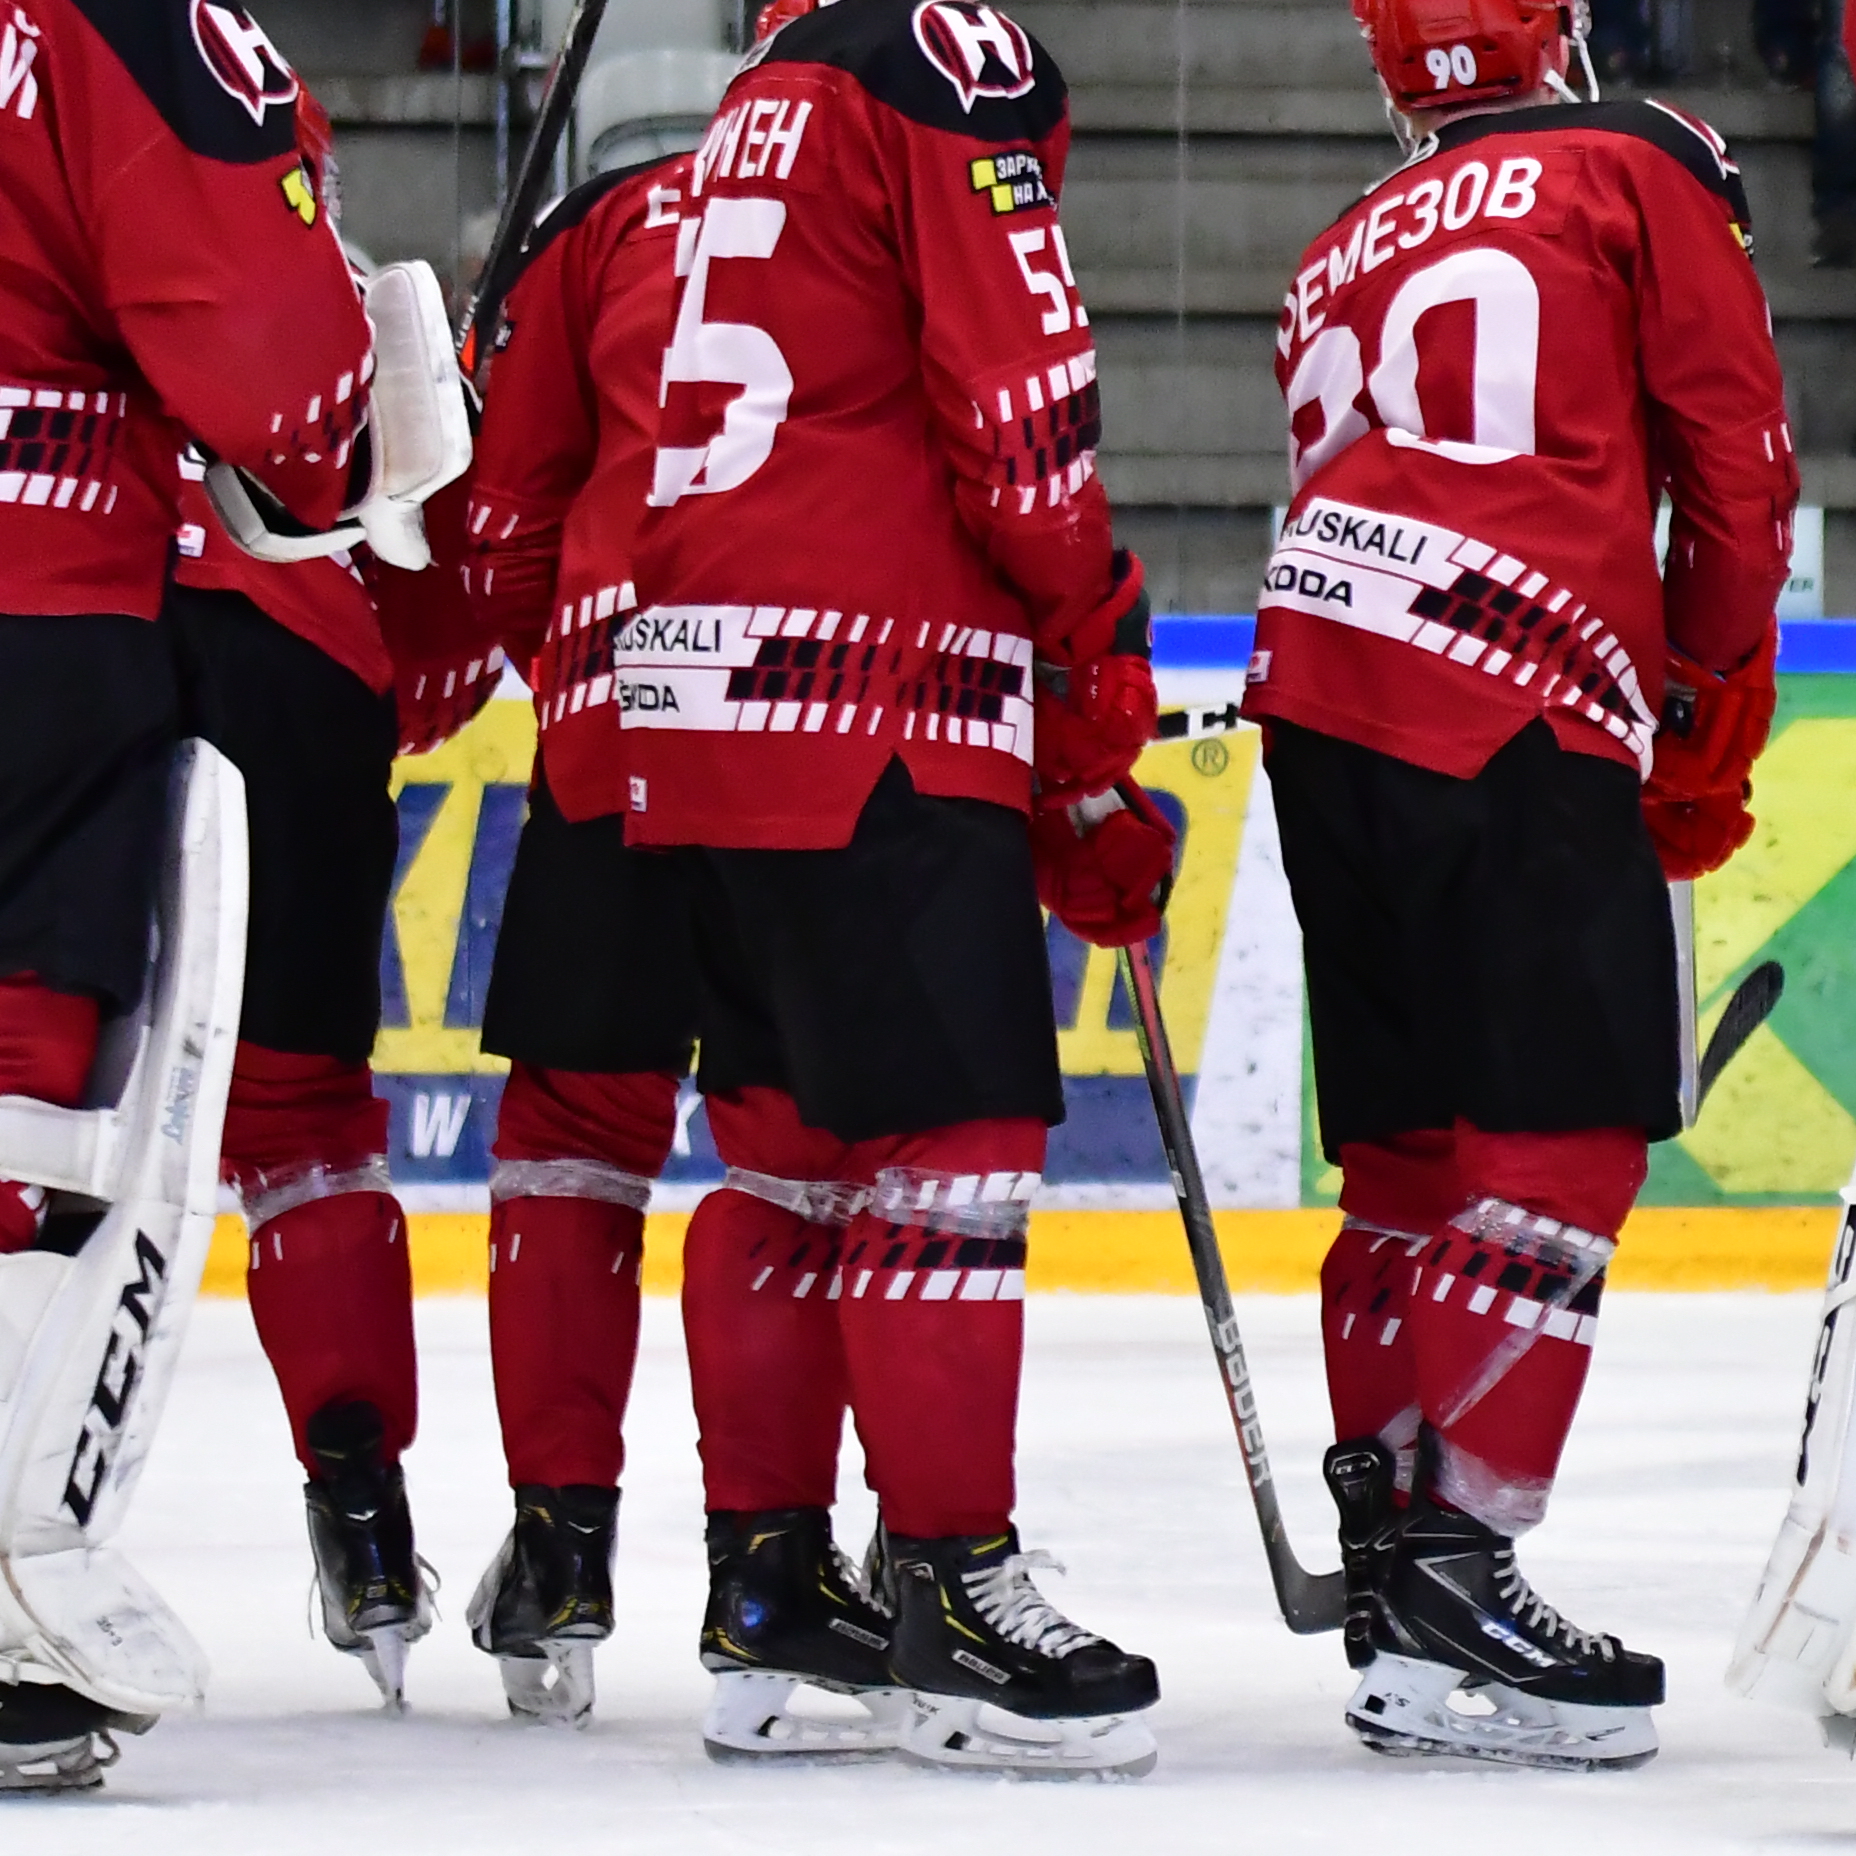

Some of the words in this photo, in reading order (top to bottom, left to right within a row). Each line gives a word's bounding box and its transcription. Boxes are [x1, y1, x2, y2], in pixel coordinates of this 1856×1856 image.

[1426, 45, 1477, 89] 90
[61, 1228, 168, 1528] CCM
[1480, 1619, 1558, 1669] CCM
